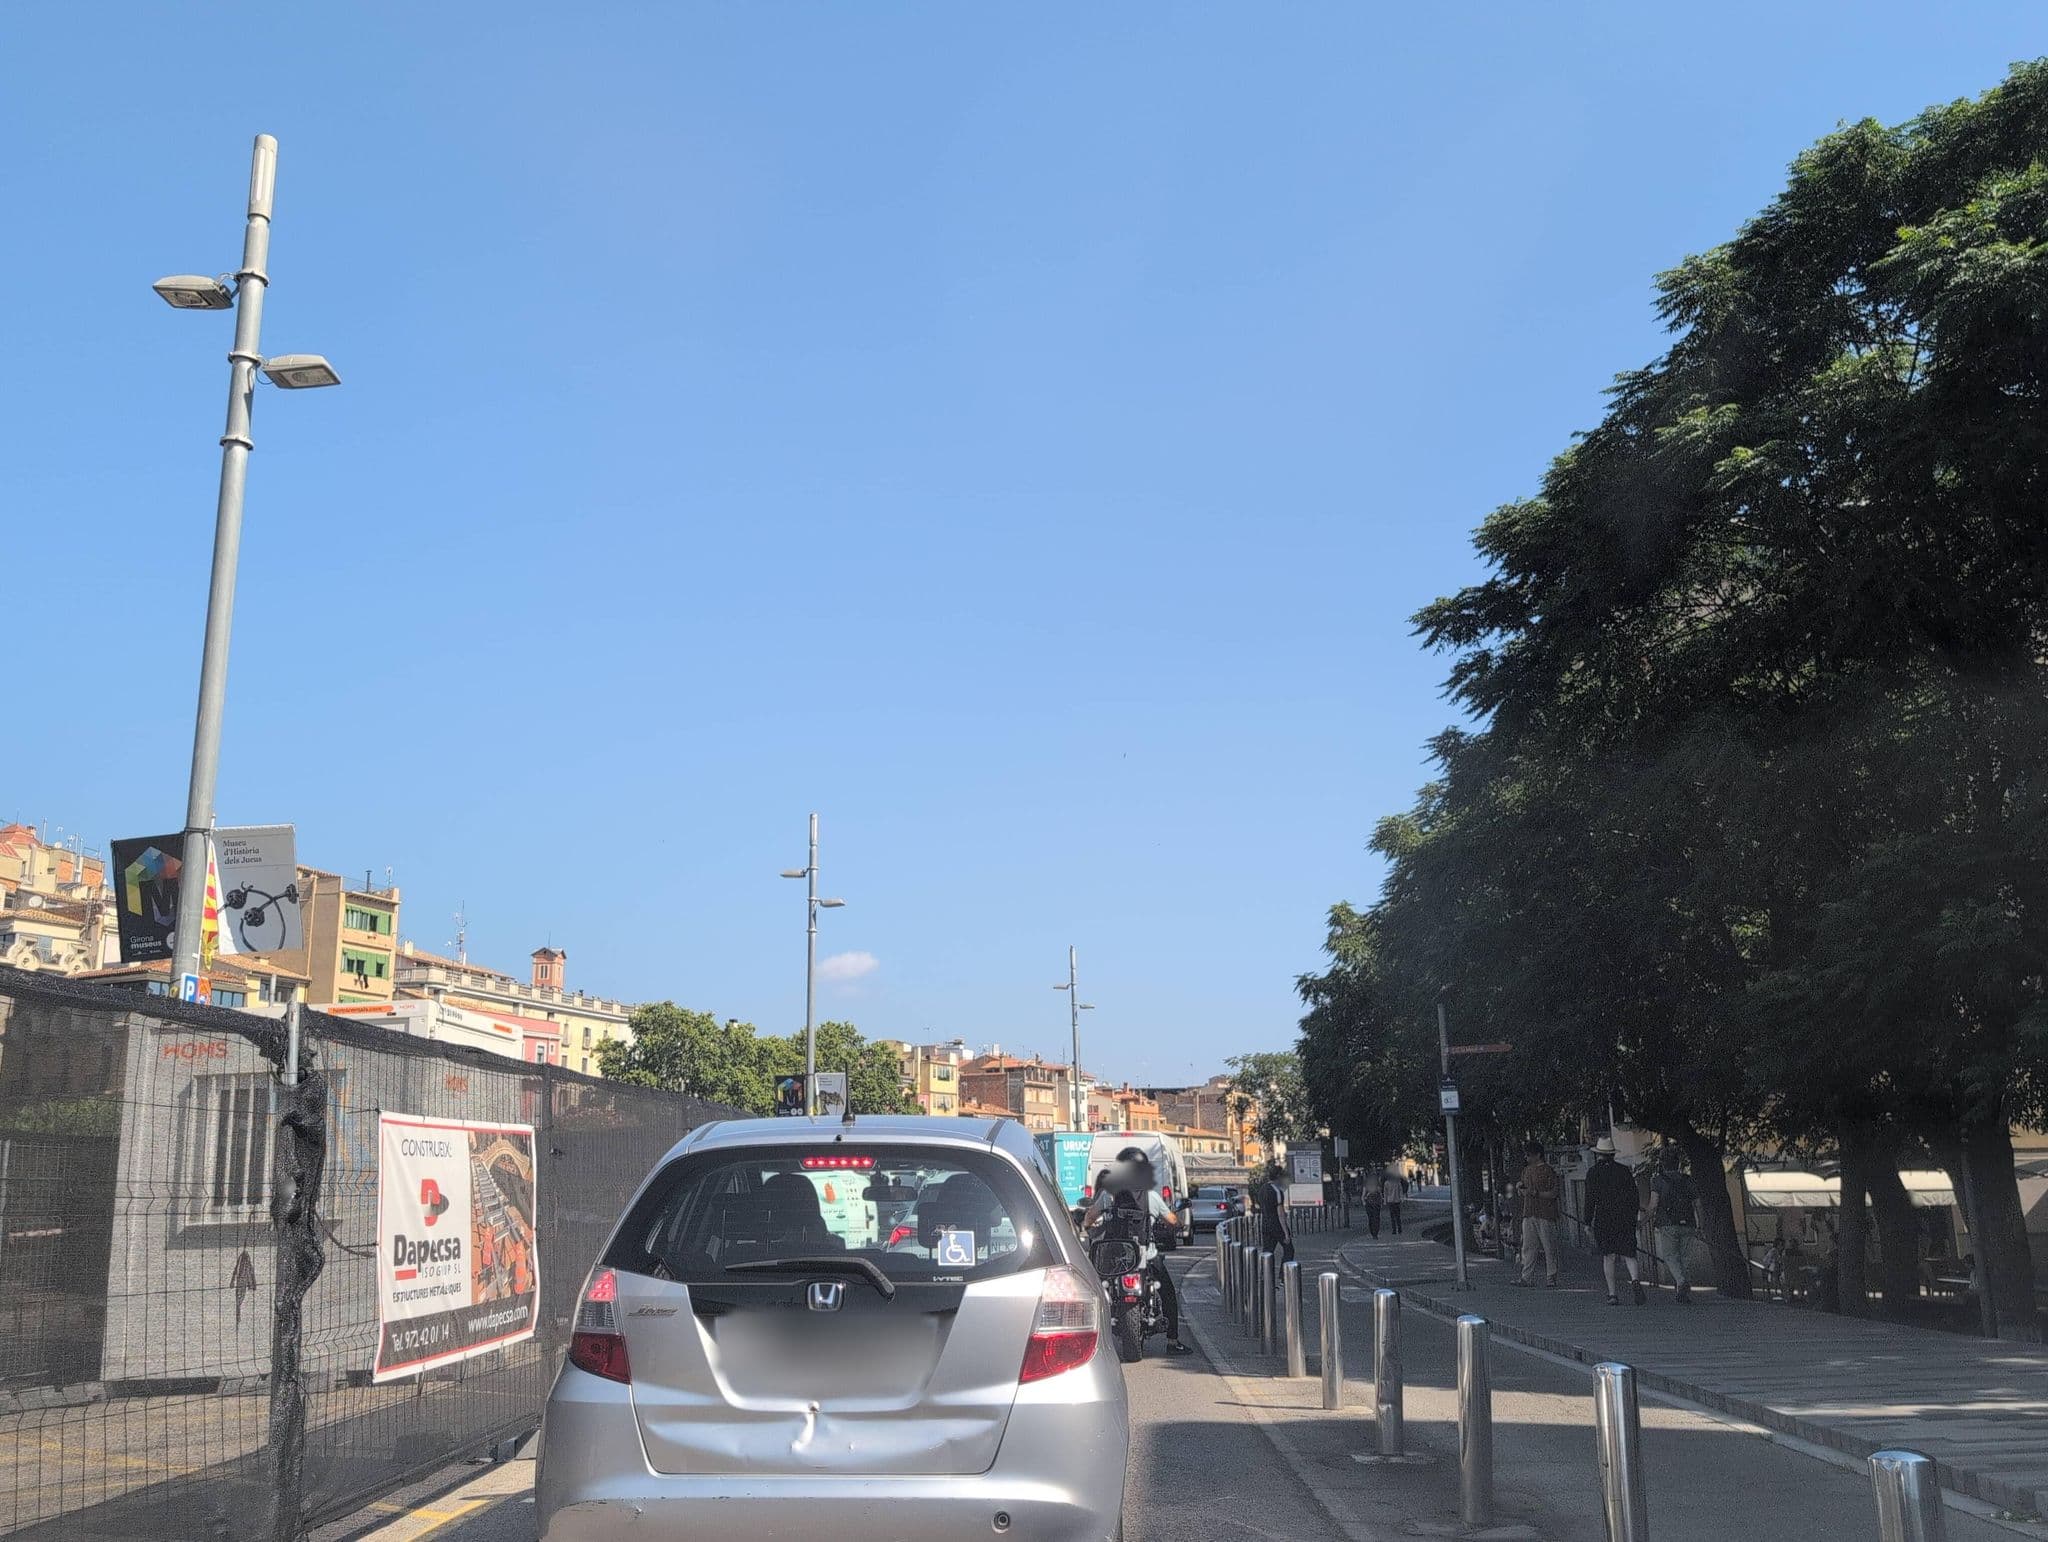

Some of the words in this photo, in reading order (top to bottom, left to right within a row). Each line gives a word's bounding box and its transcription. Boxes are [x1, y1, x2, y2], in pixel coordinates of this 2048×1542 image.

[223, 839, 247, 847] Museu
[223, 846, 260, 856] d'Història
[224, 855, 240, 865] dels
[241, 855, 263, 864] Jueus
[130, 935, 154, 944] Girona
[130, 940, 162, 950] museus
[186, 979, 196, 1002] P
[393, 1234, 462, 1273] Dapecsa
[454, 1263, 462, 1275] SL
[467, 1304, 529, 1334] www.dapecsa.com
[404, 1330, 420, 1350] 972
[420, 1327, 430, 1346] 42
[430, 1324, 439, 1344] 01
[441, 1322, 450, 1341] 14
